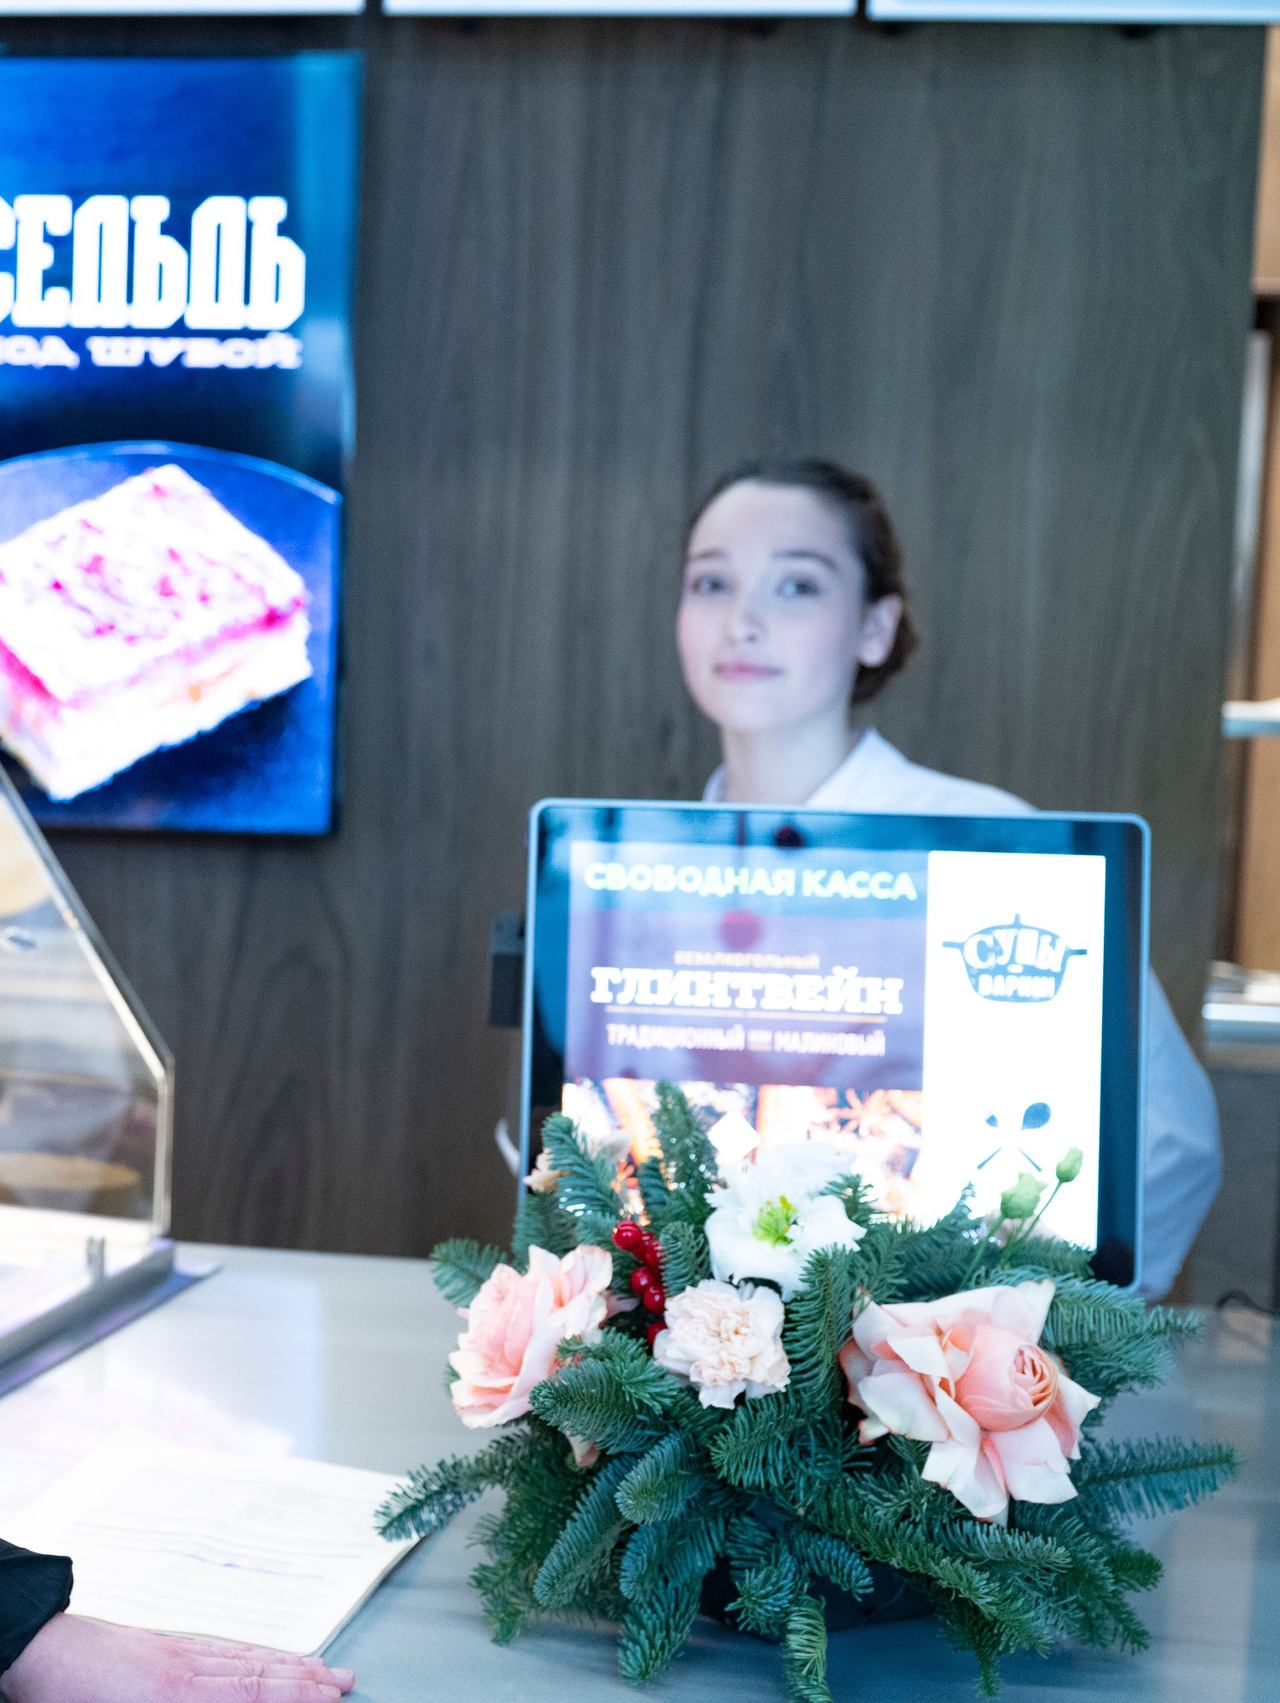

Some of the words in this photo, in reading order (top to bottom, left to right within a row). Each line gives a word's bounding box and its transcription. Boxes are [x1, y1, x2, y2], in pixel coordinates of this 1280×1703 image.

[86, 331, 303, 370] ШУБОЙ
[584, 862, 796, 897] СВОБОДНАЯ
[802, 869, 917, 900] КАССА
[590, 966, 904, 1014] ГЛИНТВЕЙН
[606, 1023, 745, 1051] ТРАДИЦИОННЫЙ
[774, 1029, 886, 1056] МАЛИНОВЫЙ
